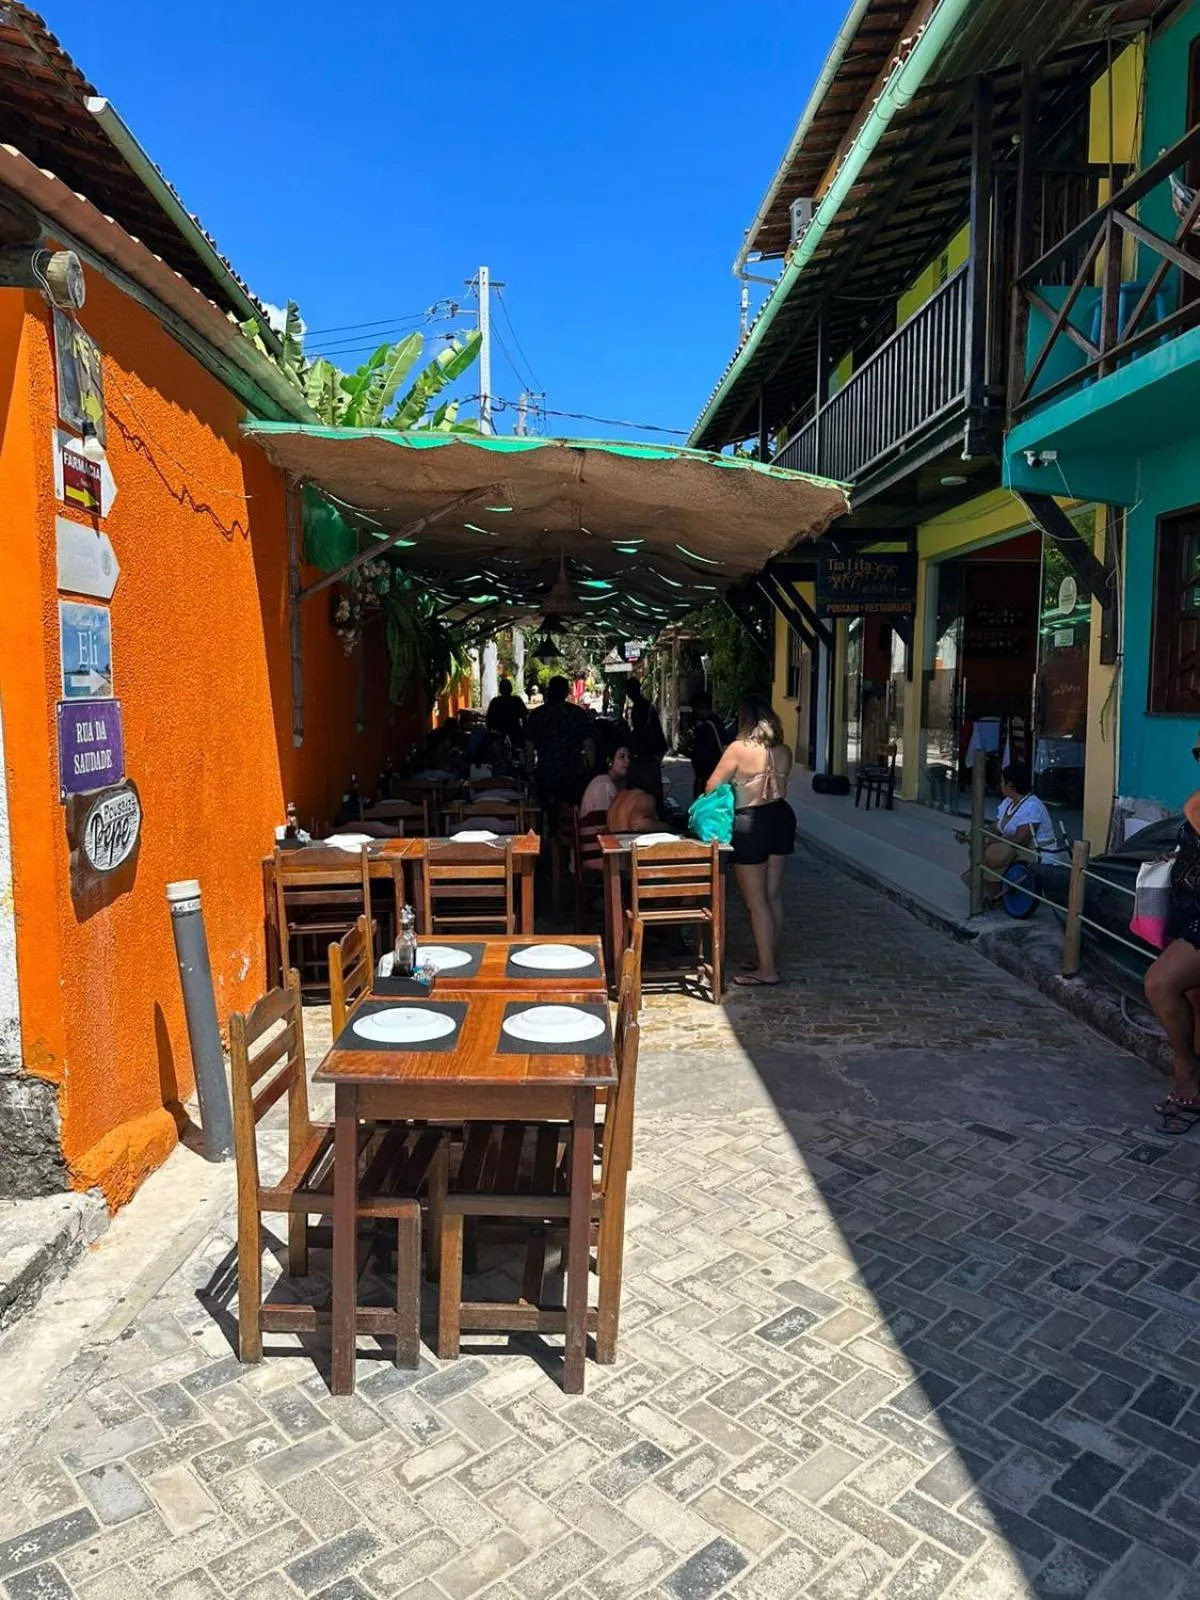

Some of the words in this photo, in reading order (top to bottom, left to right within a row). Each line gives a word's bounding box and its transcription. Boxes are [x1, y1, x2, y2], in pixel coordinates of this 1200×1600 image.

[78, 631, 98, 665] Eli
[76, 722, 94, 744] RUA
[95, 720, 107, 740] DA
[74, 749, 112, 775] SAUDADE
[91, 812, 131, 866] Pepe
